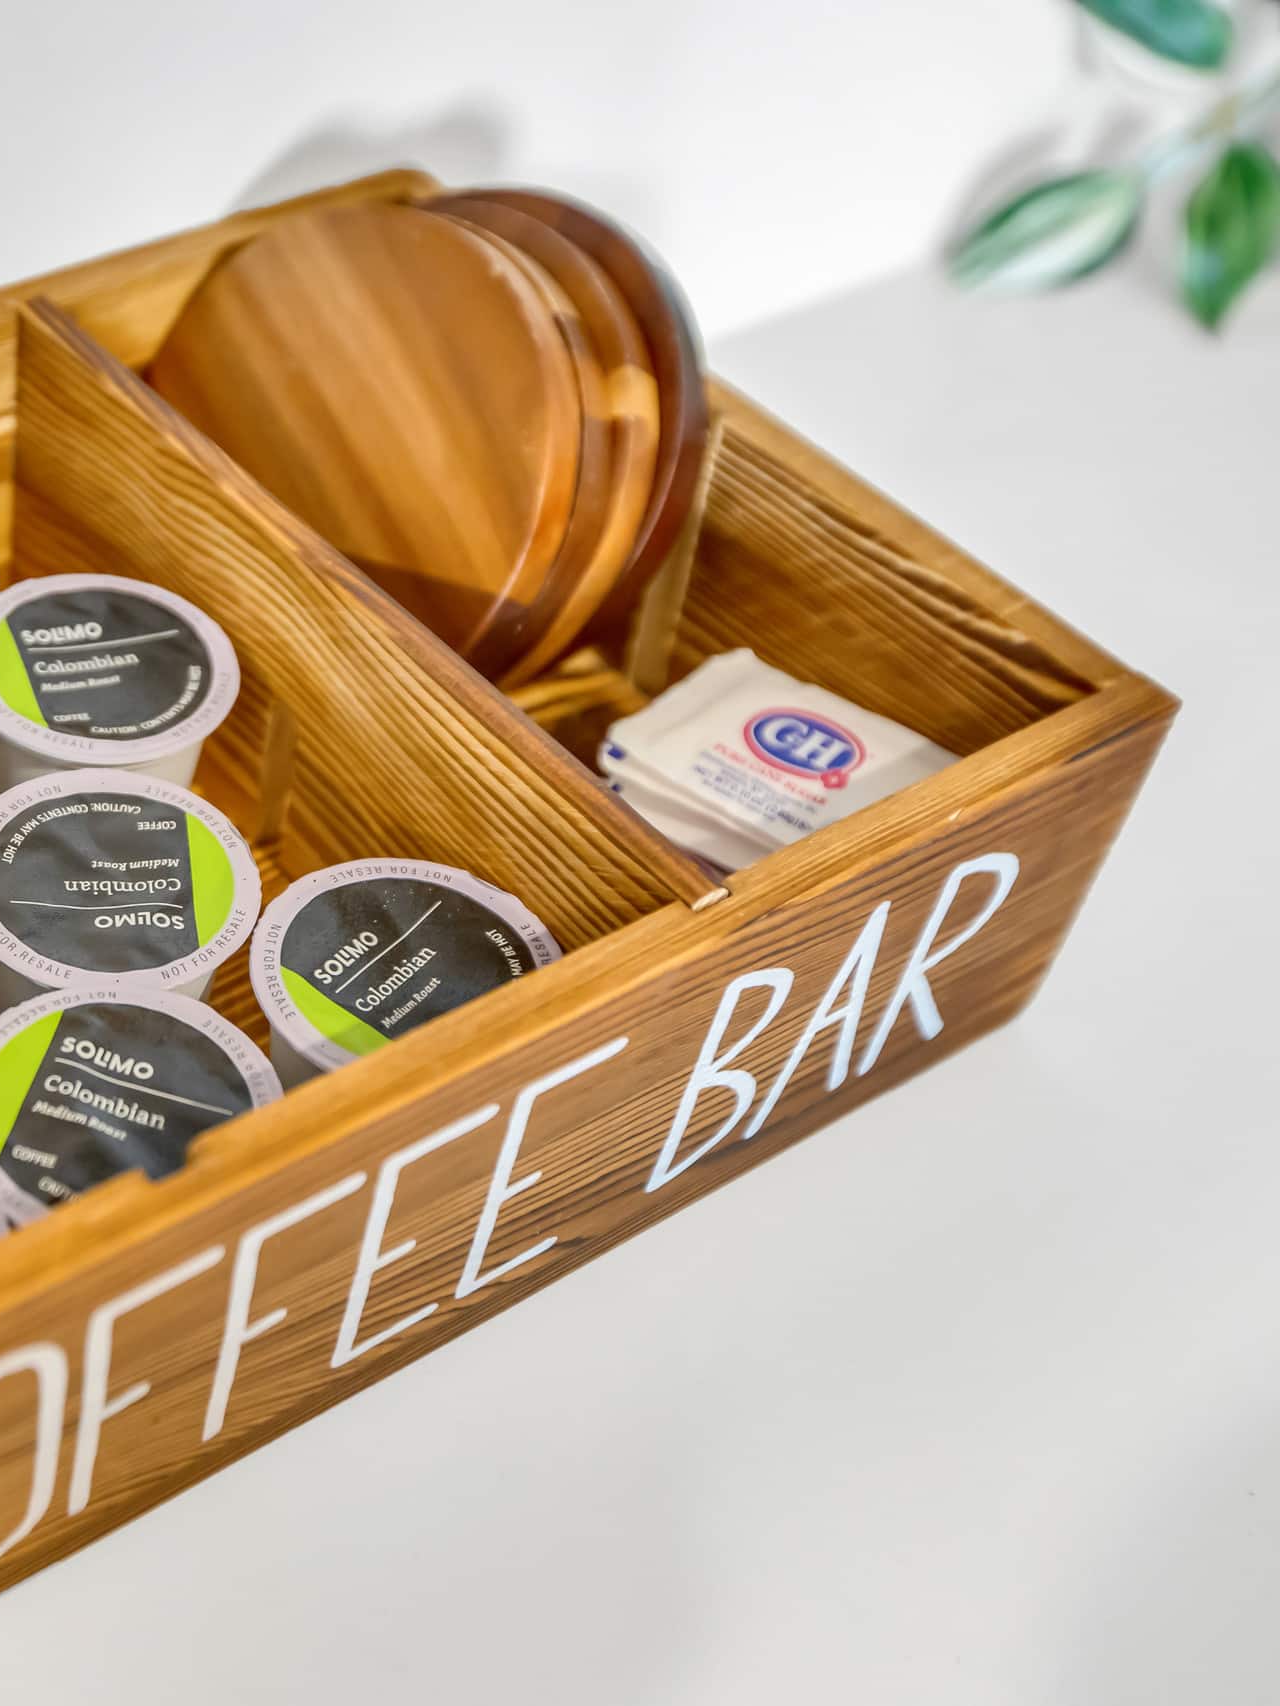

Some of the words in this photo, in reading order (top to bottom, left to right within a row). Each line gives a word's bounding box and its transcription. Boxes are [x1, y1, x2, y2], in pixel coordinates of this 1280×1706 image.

[21, 621, 102, 645] SOLIMO
[34, 652, 140, 674] Colombian
[761, 717, 849, 771] GH
[37, 784, 63, 797] NOT
[12, 795, 34, 810] FOR
[92, 802, 141, 814] CAUTION:
[37, 804, 89, 825] CONTENTS
[23, 822, 39, 837] MAY
[137, 821, 176, 830] COFFEE
[10, 836, 24, 849] BE
[1, 846, 19, 864] HOT
[131, 858, 180, 870] Medium
[91, 860, 127, 872] Roast
[331, 866, 382, 884] RESALE
[389, 866, 416, 874] FOR
[424, 870, 452, 882] NOT
[64, 878, 181, 895] Colombian
[94, 911, 184, 929] SOLIMO
[160, 963, 188, 980] NOT
[192, 947, 216, 967] FOR
[215, 909, 248, 947] RESALE
[269, 924, 282, 946] NOT
[19, 951, 72, 979] RESALE
[263, 951, 278, 971] FOR
[313, 930, 379, 985] SOLIMO
[355, 945, 437, 1013] Colombian
[266, 972, 296, 1021] RESALE
[380, 999, 418, 1029] Medium
[413, 976, 441, 1003] Roast
[642, 850, 1022, 1196] BAR
[60, 1036, 155, 1079] SOLIMO
[43, 1074, 166, 1130] Colombian
